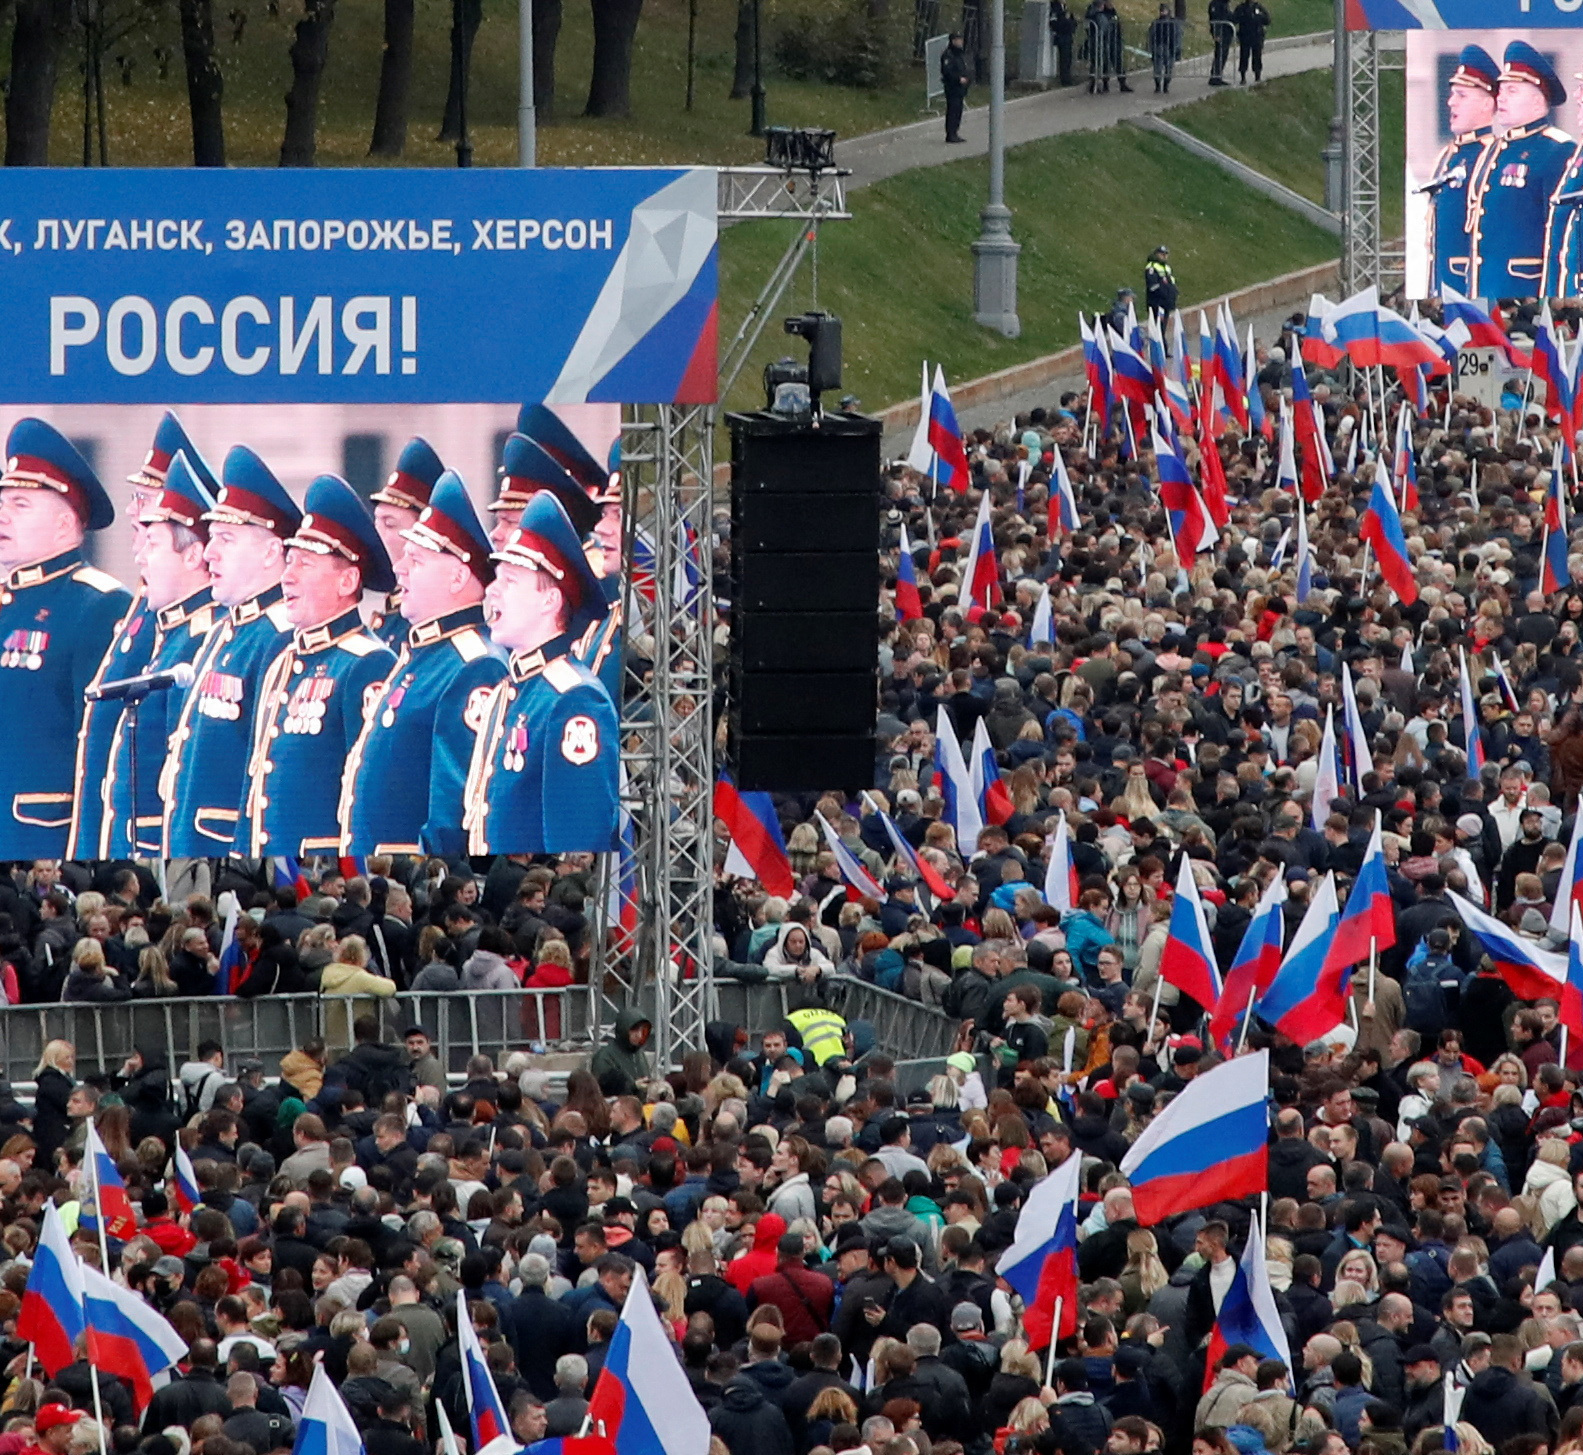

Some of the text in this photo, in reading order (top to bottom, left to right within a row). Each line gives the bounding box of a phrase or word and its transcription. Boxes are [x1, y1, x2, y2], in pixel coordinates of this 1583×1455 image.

[33, 219, 212, 255] ЛУГАНСК,
[225, 219, 461, 255] ЗАПОРОЖЬЕ,
[471, 218, 613, 250] ХЕРСОН
[50, 295, 417, 375] РОССИЯ!
